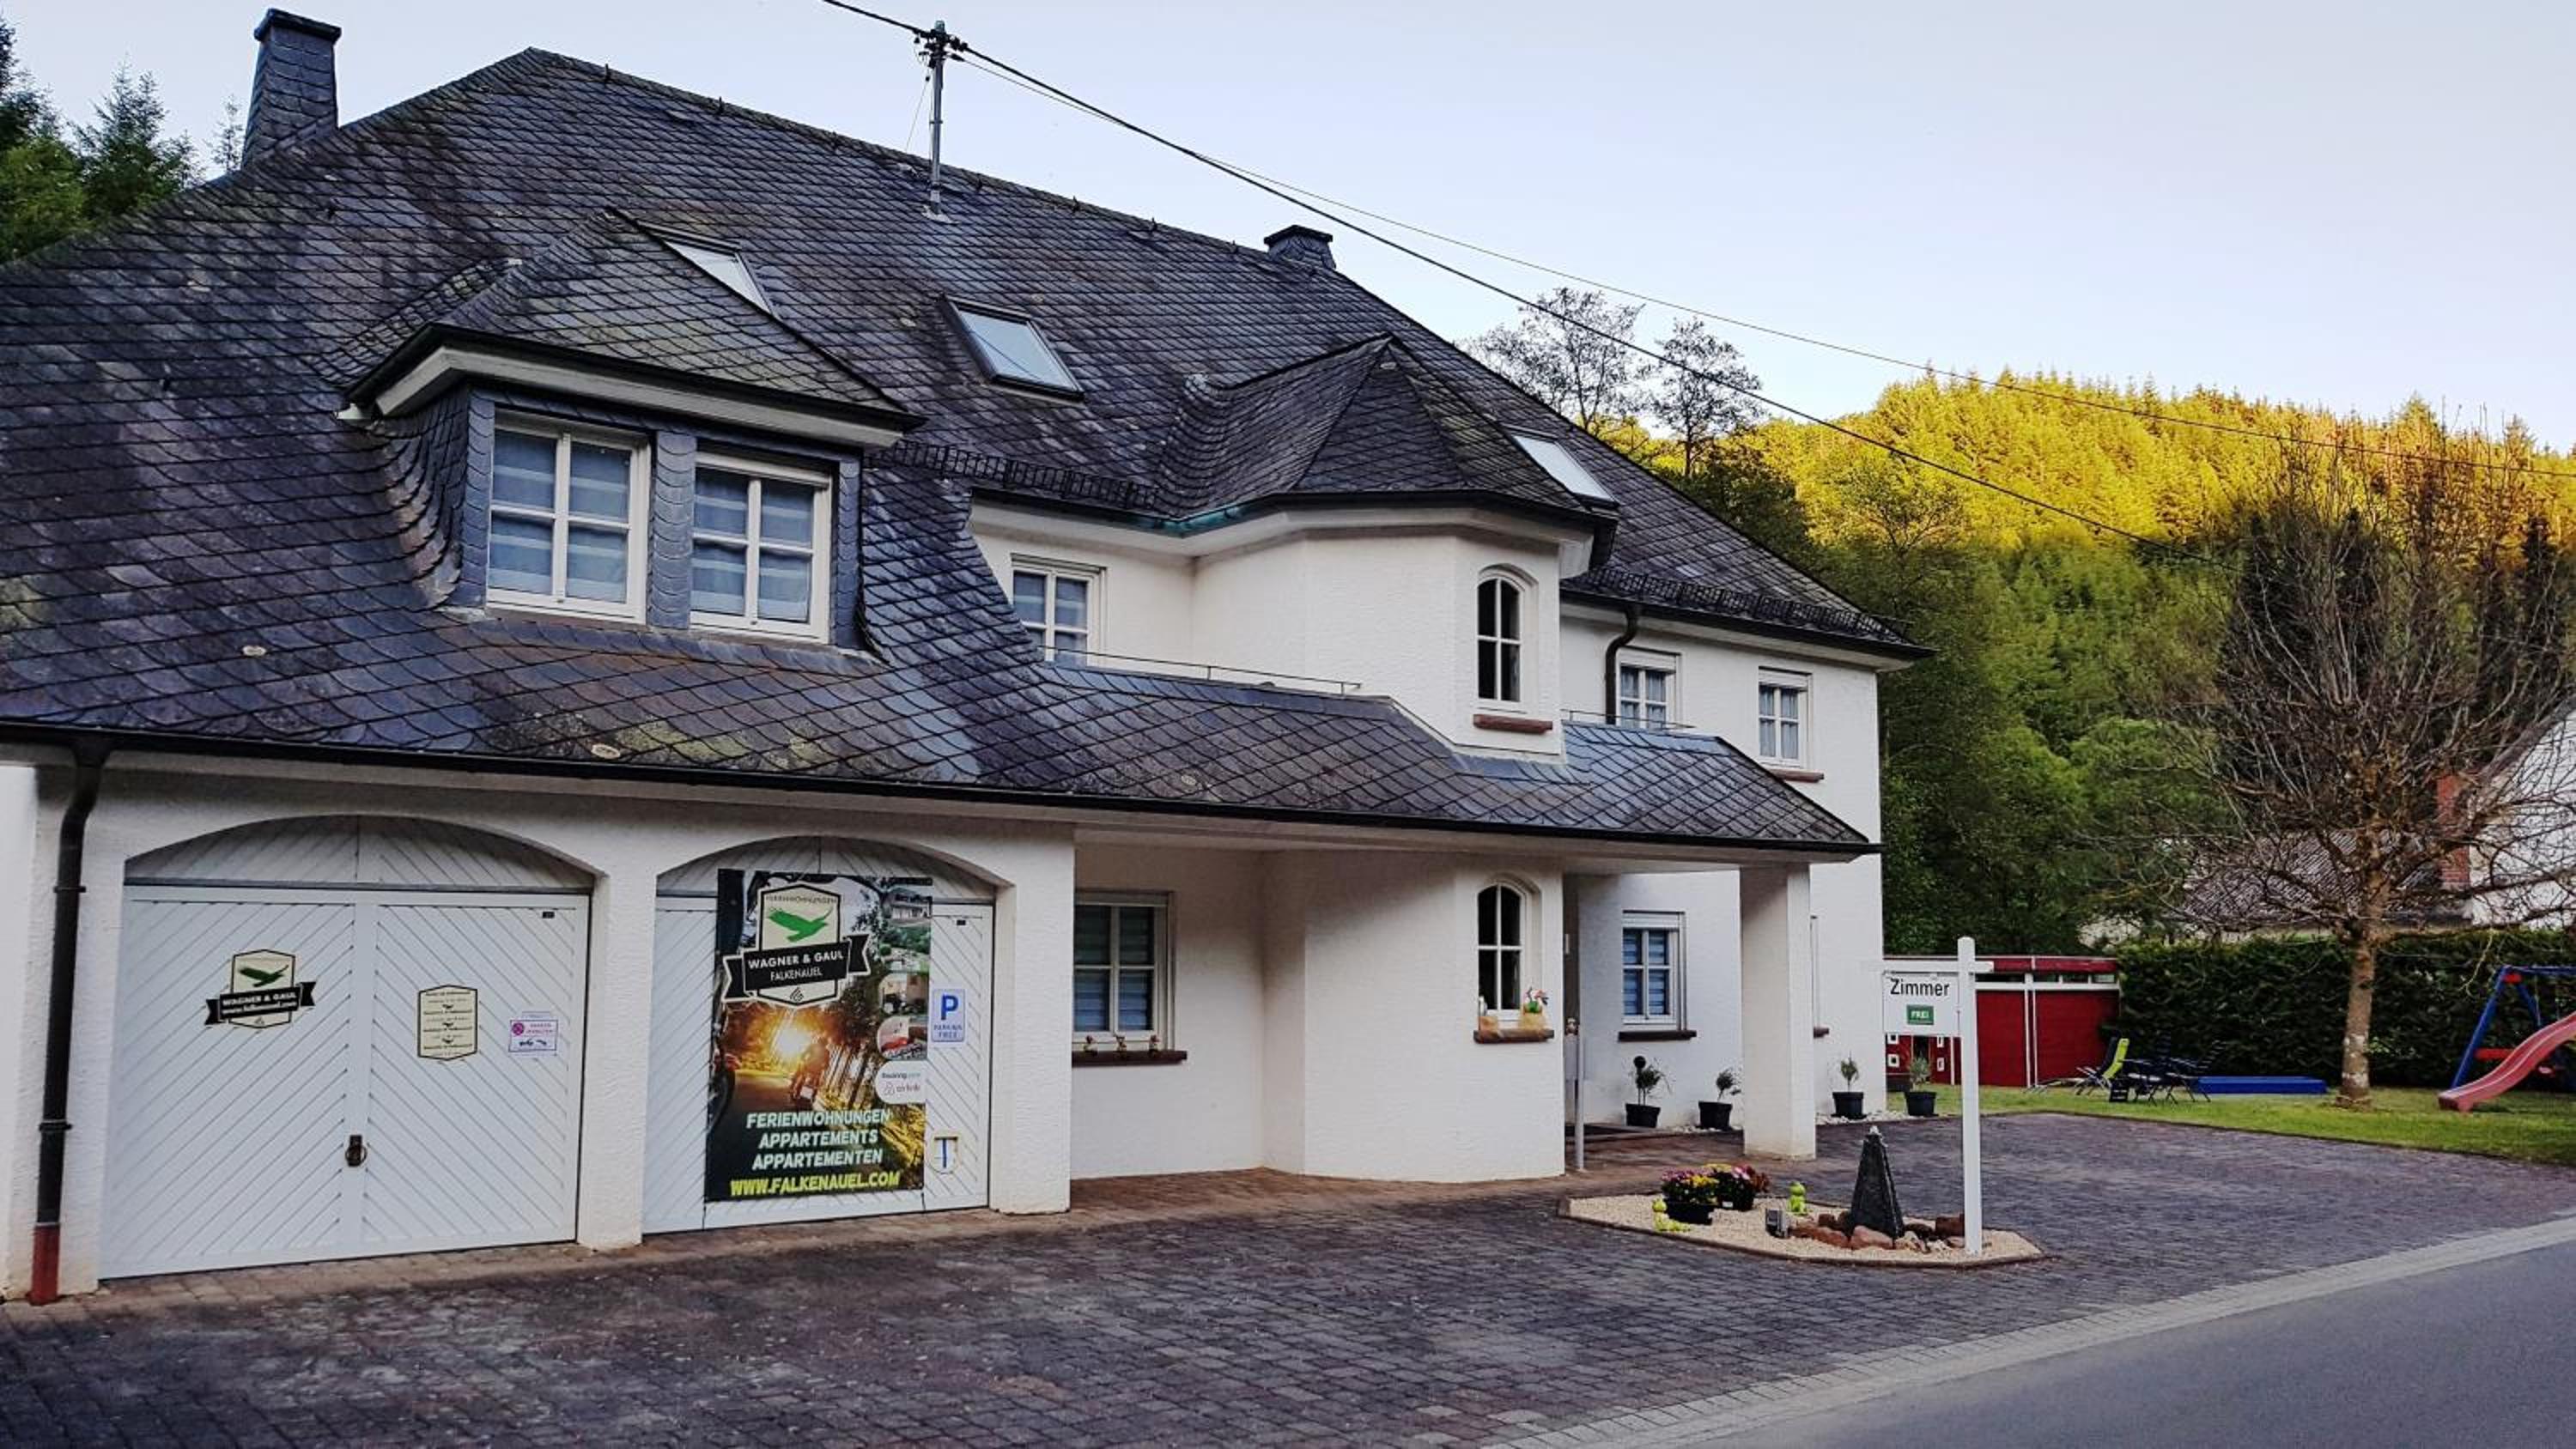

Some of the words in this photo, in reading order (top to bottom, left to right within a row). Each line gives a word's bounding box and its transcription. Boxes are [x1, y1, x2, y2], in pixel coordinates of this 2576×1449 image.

[748, 955, 799, 970] WAGNER
[803, 953, 811, 964] &
[814, 949, 844, 962] GAUL
[770, 967, 823, 981] FALKENAUEL
[1890, 977, 1950, 997] Zimmer
[941, 994, 959, 1021] P
[745, 1109, 891, 1129] FERIENWOHNUNGEN
[758, 1129, 878, 1149] APPARTEMENTS
[751, 1149, 884, 1171] APPARTEMENTEN
[730, 1171, 901, 1197] WWW.FALKENAUEL.COM
